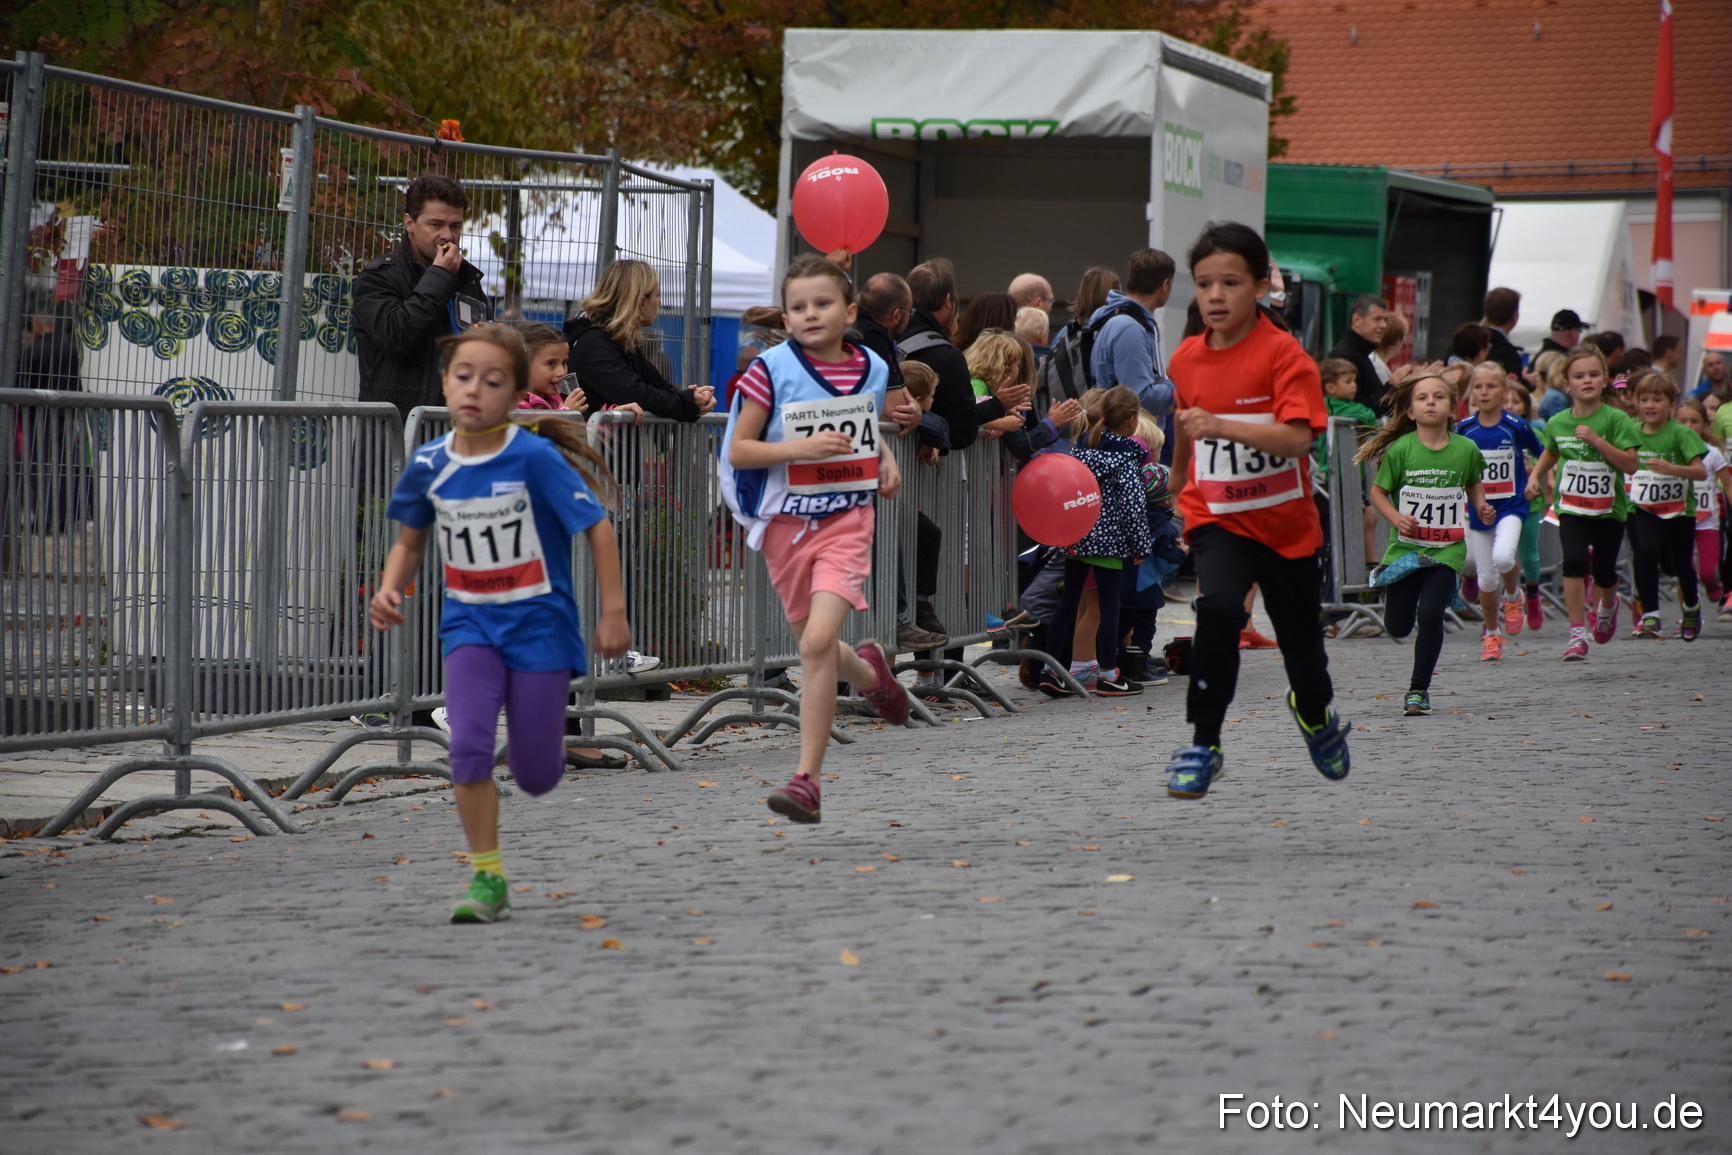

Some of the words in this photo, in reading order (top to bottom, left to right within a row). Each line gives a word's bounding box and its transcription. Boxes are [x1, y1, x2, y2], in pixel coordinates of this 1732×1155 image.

[1163, 121, 1203, 199] BOCK
[785, 411, 820, 422] PARTL
[821, 405, 865, 419] Neumarkt
[795, 418, 875, 454] 724
[816, 464, 864, 483] Sophia
[1225, 482, 1267, 500] Sarah
[1567, 473, 1611, 495] 7053
[1638, 483, 1683, 501] 7033
[1401, 491, 1424, 500] PARTL
[1407, 501, 1457, 526] 7411
[441, 519, 522, 565] 7117
